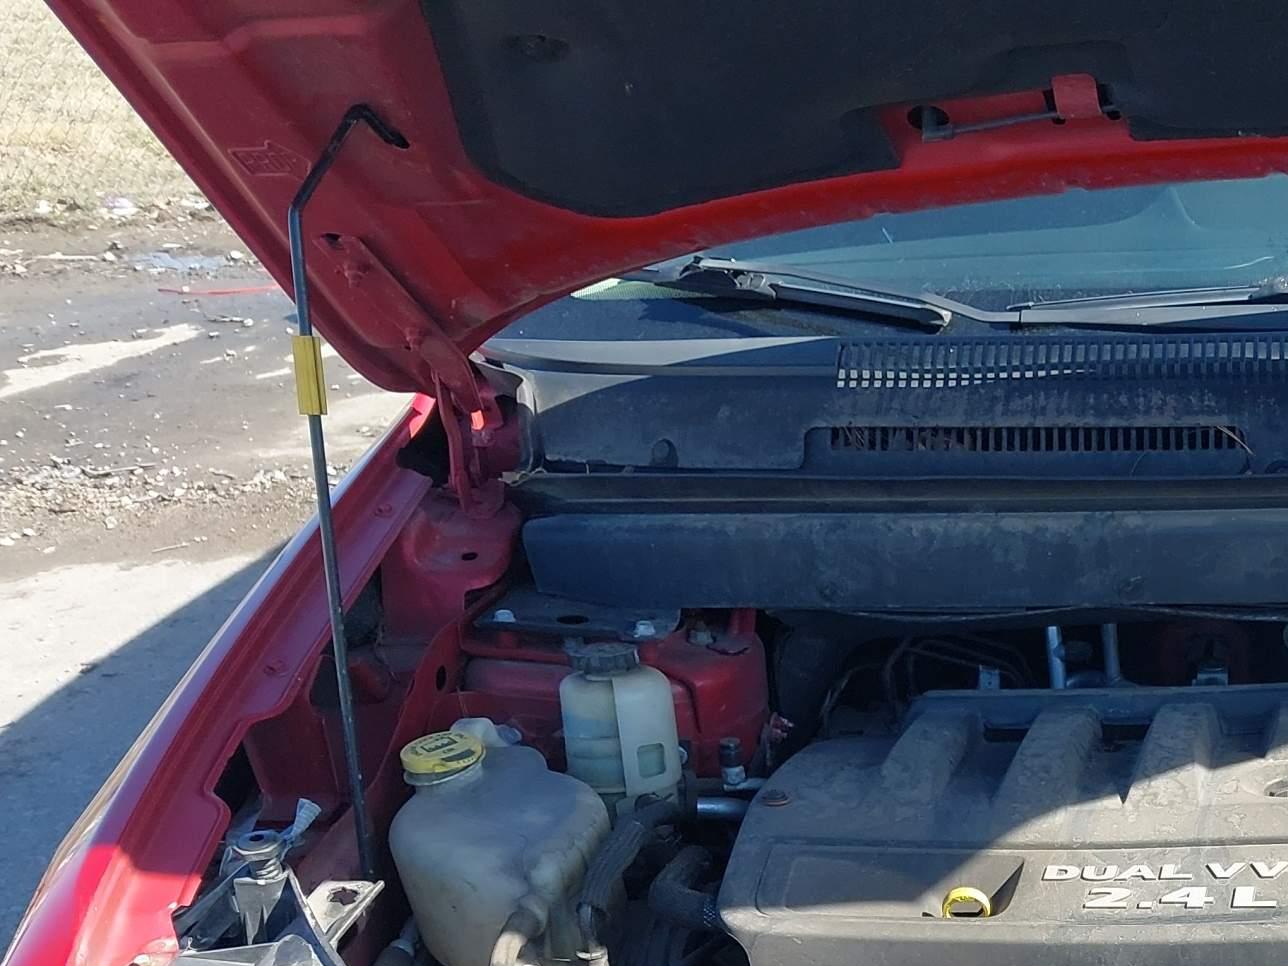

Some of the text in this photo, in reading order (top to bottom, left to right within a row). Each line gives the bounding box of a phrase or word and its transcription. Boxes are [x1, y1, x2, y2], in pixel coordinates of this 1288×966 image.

[1041, 863, 1193, 881] DUAL
[1082, 886, 1277, 910] 2.4 L
